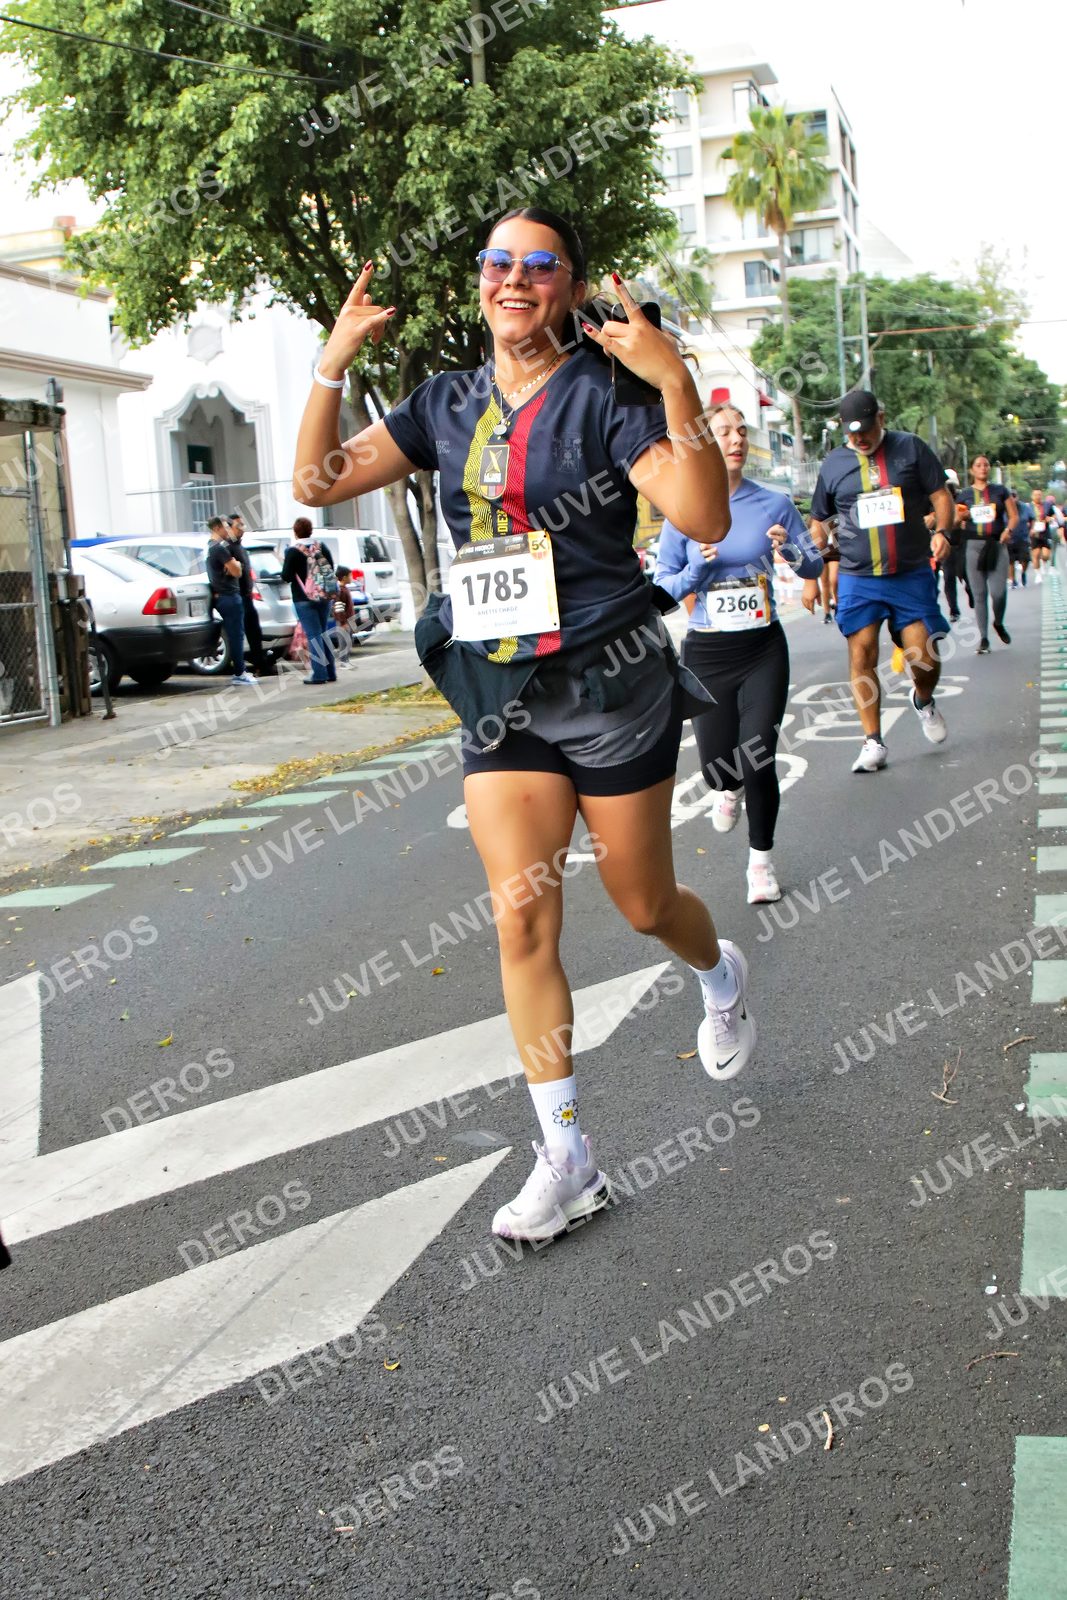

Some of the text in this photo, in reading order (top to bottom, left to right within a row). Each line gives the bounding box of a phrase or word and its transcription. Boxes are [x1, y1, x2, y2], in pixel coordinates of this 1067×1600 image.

[865, 500, 893, 513] 1742
[462, 567, 528, 606] 1785
[717, 594, 758, 613] 2366
